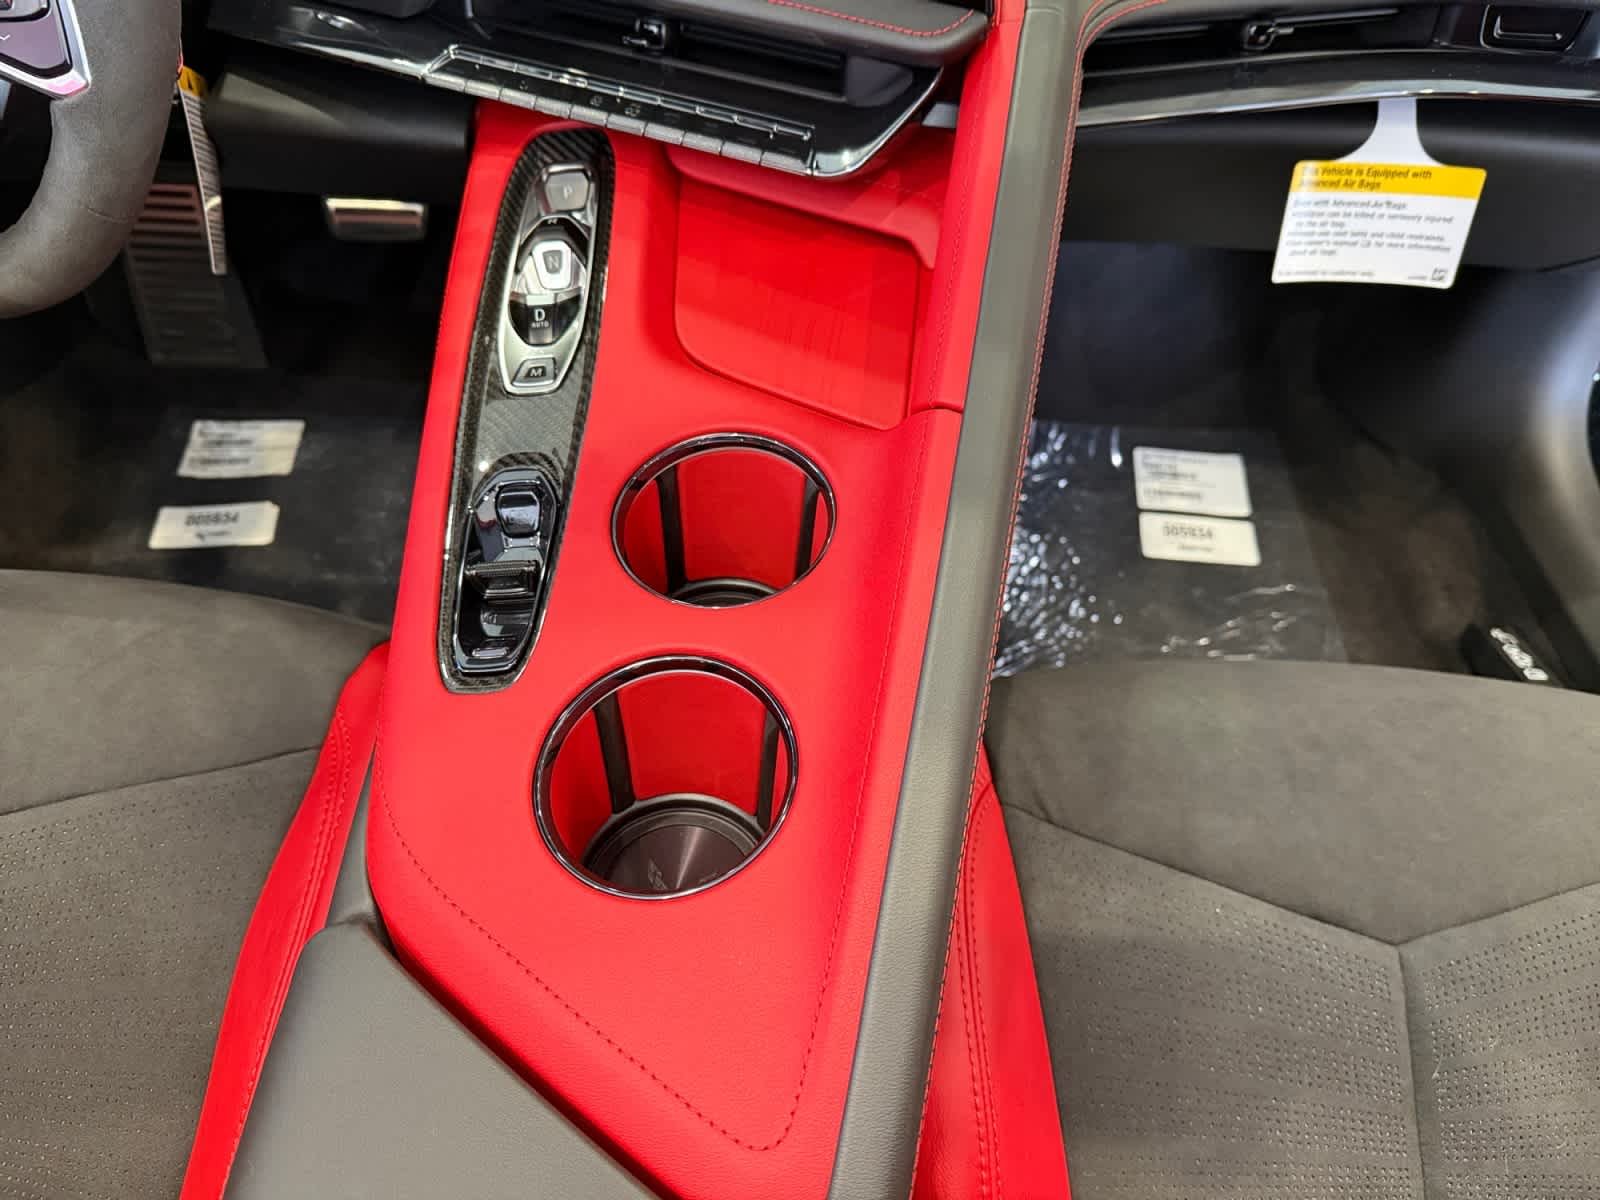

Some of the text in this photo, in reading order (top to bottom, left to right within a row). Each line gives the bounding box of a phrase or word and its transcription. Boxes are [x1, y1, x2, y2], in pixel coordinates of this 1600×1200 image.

[1321, 167, 1353, 177] Vehicle
[1355, 169, 1363, 177] is
[1366, 168, 1409, 179] Equipped
[1412, 170, 1432, 179] with
[1343, 179, 1356, 188] Air
[1358, 179, 1381, 190] Bags
[534, 308, 546, 322] D
